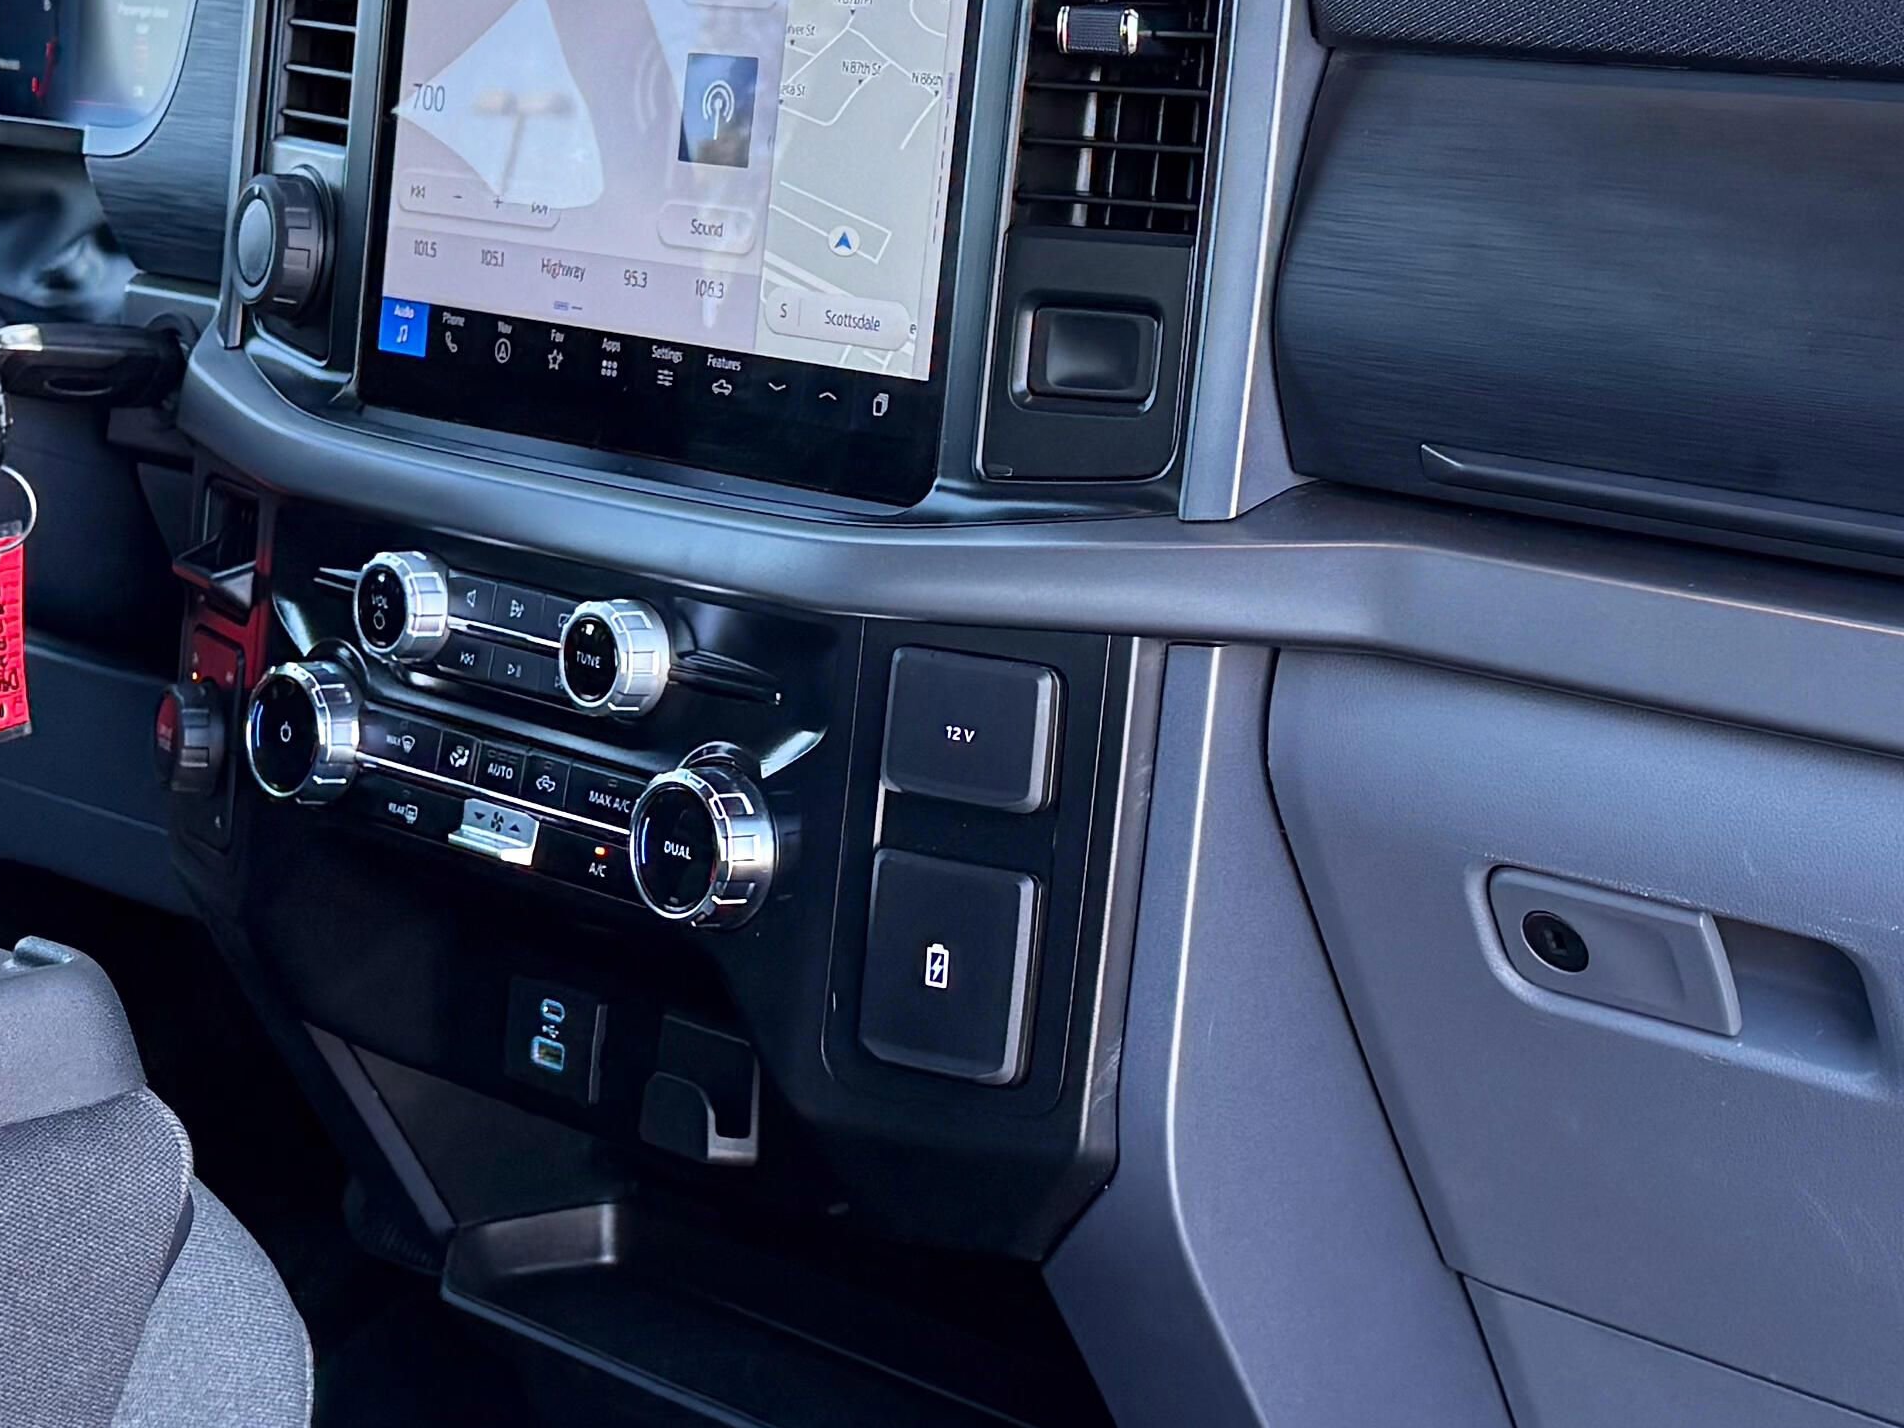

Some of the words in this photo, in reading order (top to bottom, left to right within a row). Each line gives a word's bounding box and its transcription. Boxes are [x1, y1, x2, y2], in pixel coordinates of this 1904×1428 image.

[412, 82, 446, 113] 700
[689, 218, 725, 238] Sound
[540, 257, 587, 283] Highway
[623, 268, 649, 289] 95.3
[695, 278, 725, 300] 106.3
[778, 302, 788, 319] S
[823, 308, 882, 333] Scottsdale
[393, 304, 416, 320] Audio
[601, 337, 622, 354] Apps
[650, 343, 685, 365] Settings
[706, 353, 742, 372] Features
[575, 649, 602, 670] TUNE
[945, 724, 962, 742] 12
[963, 728, 976, 744] V
[486, 762, 514, 780] AUTO
[587, 789, 613, 809] MAX
[612, 797, 633, 814] A/C
[662, 839, 693, 861] DUAL
[587, 861, 608, 878] A/C
